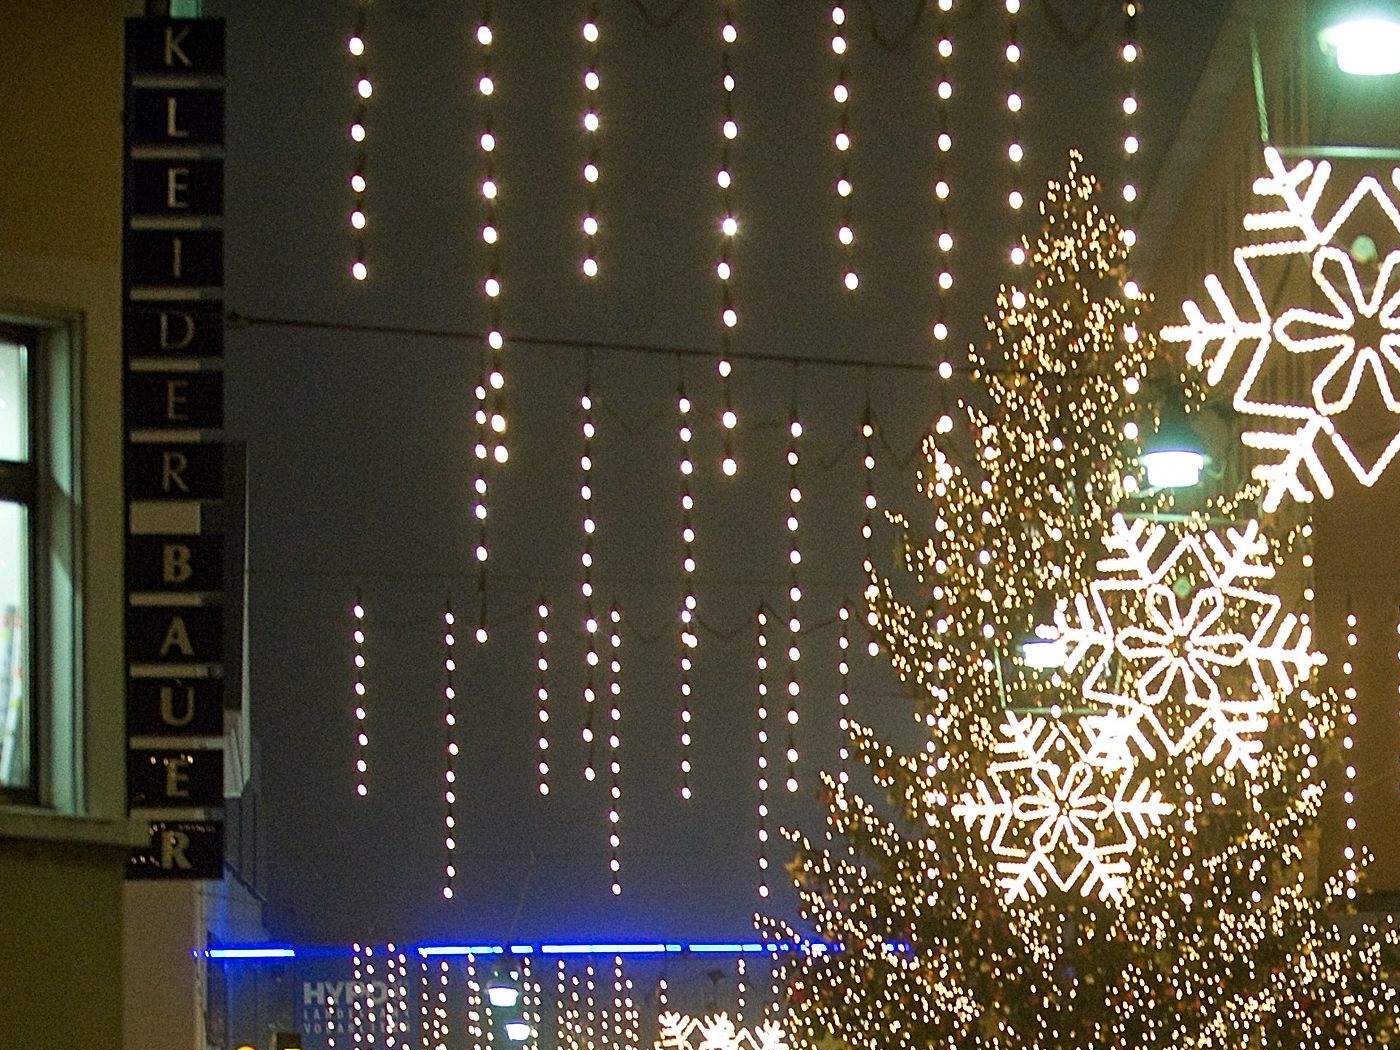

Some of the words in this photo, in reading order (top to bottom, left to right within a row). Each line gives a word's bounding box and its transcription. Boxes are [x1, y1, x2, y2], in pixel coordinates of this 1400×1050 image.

[160, 26, 196, 493] KLEIDER
[160, 544, 194, 869] BAUER
[303, 981, 388, 1006] HYPO
[304, 1008, 410, 1020] LANDESANK
